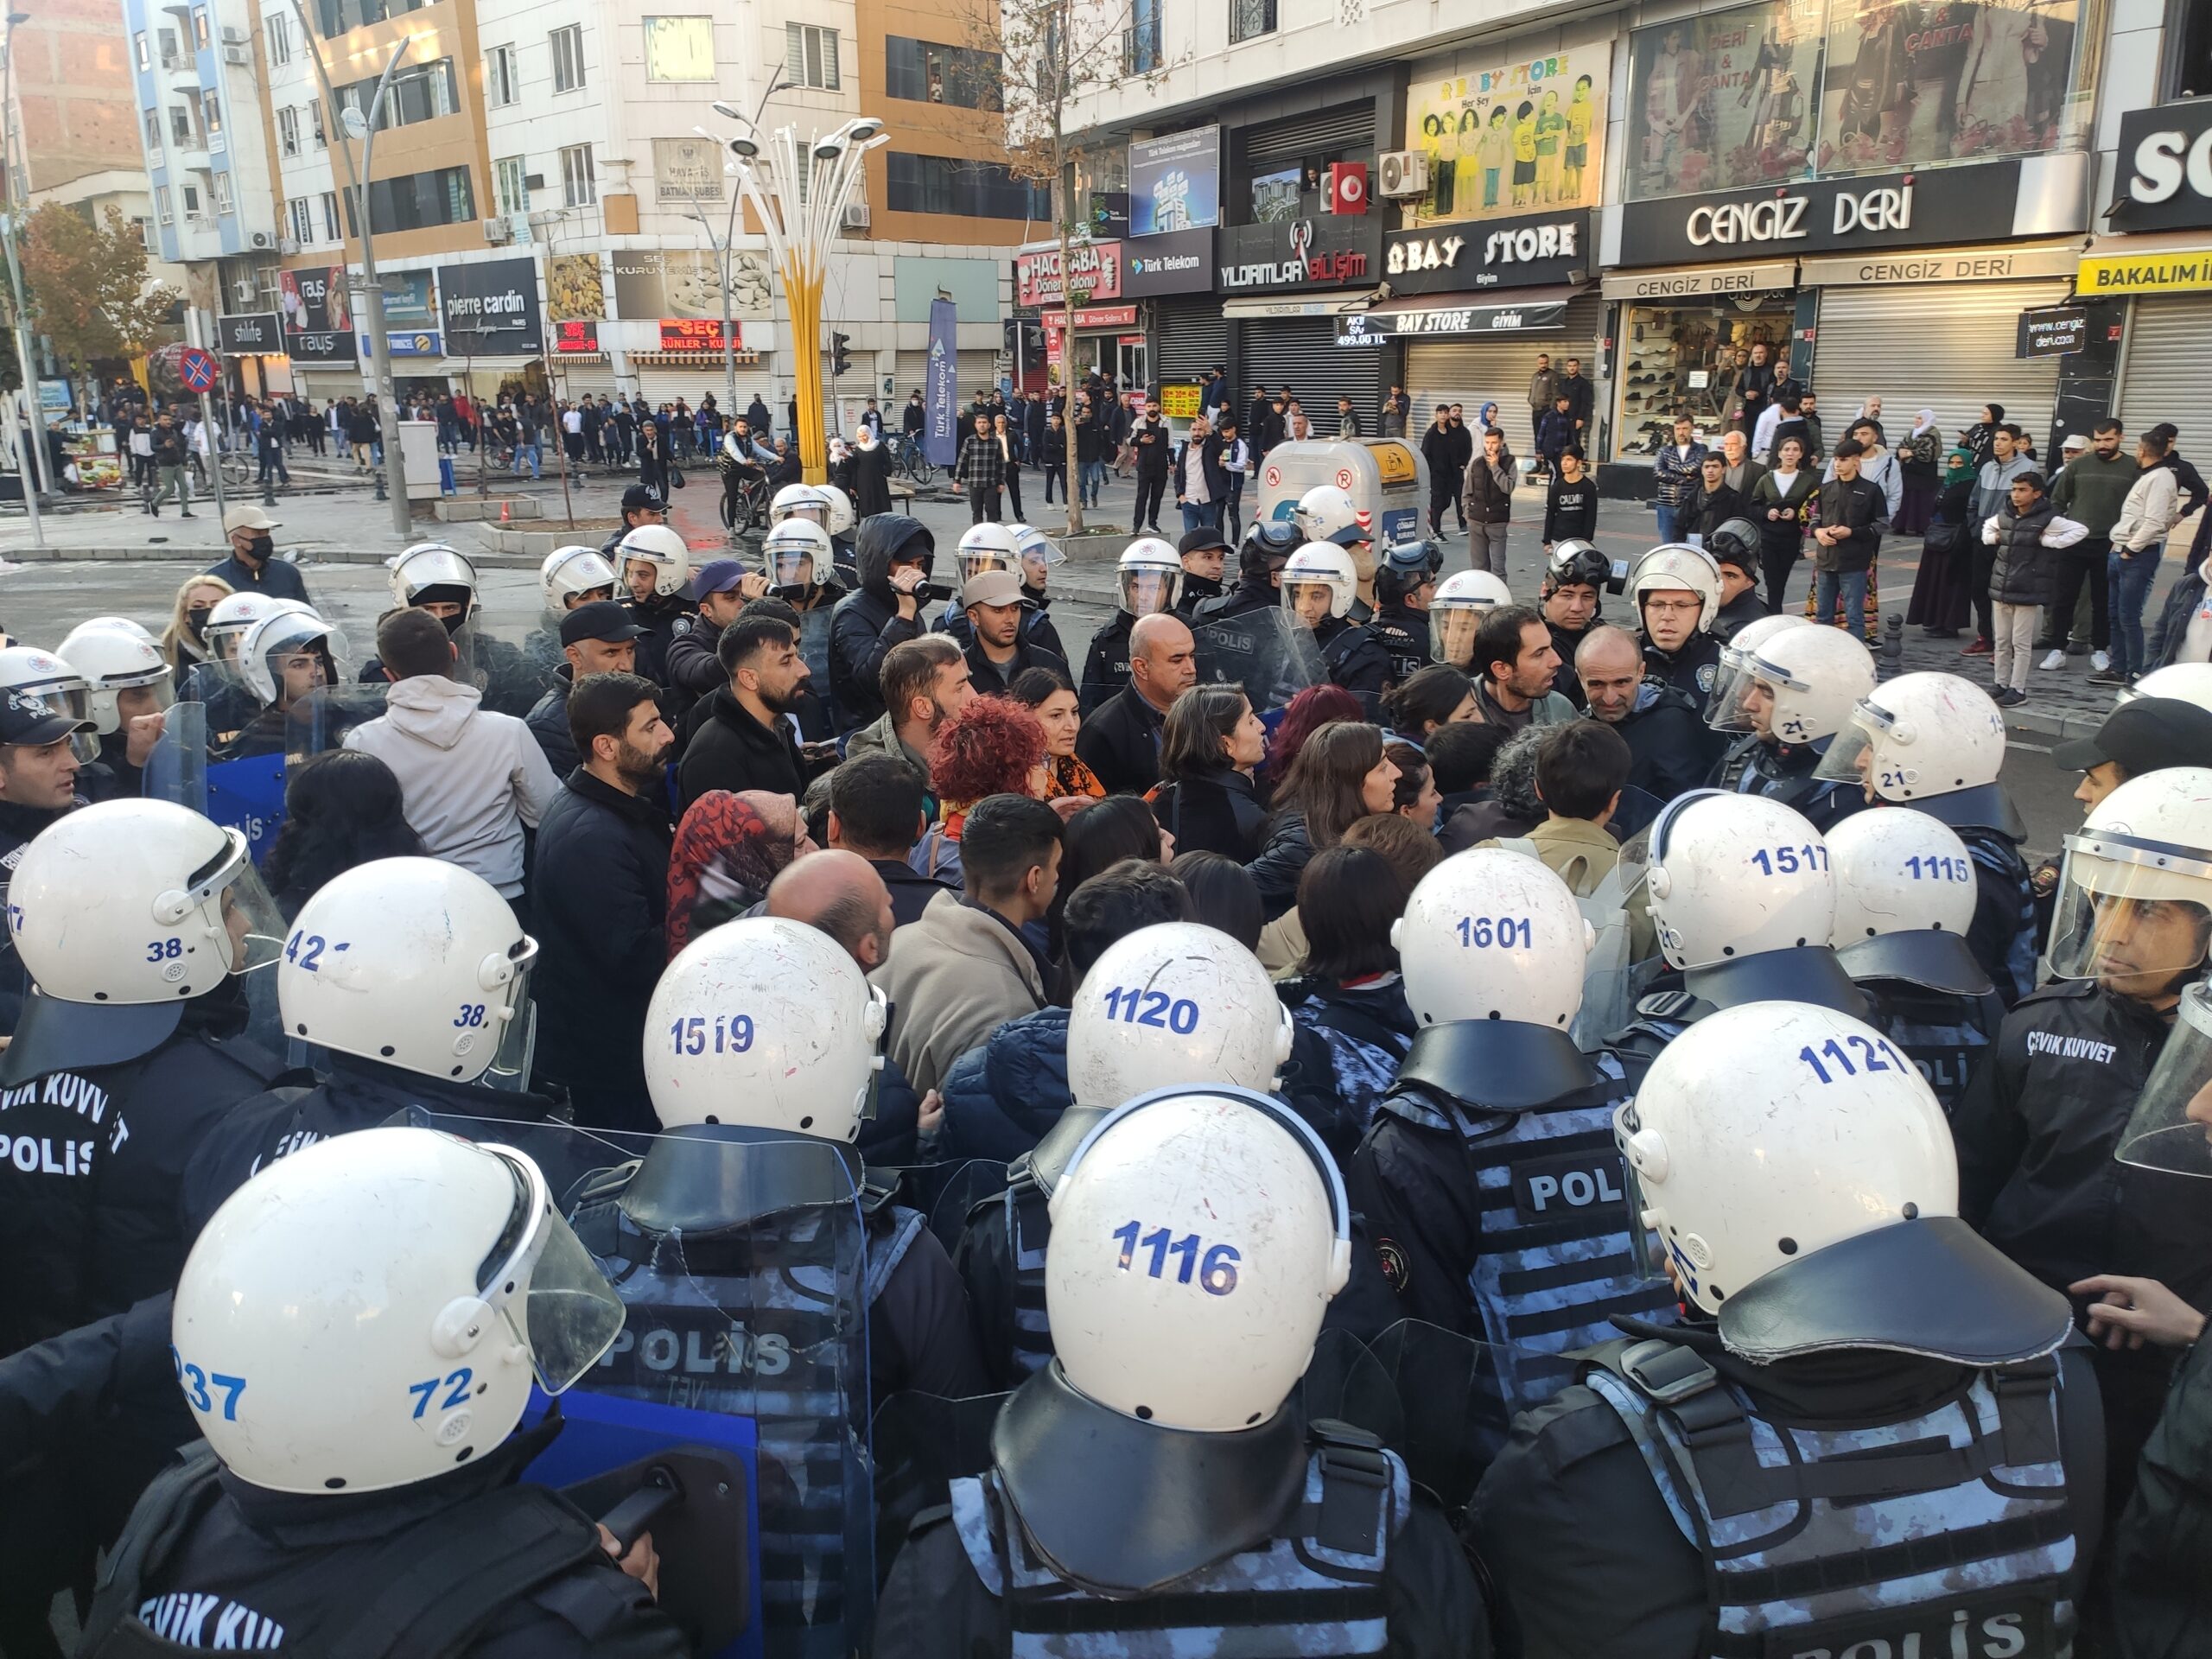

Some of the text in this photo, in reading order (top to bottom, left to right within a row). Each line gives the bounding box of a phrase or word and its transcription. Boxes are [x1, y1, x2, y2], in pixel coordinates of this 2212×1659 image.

[1456, 70, 1504, 98] BABY
[1510, 55, 1569, 87] STORE
[1462, 98, 1476, 110] Her
[1687, 175, 1916, 246] CENGİZ DERİ
[1406, 222, 1580, 271] BAY STORE
[1143, 254, 1200, 273] Türk Telekom
[1859, 255, 2013, 281] CENGİZ DERİ
[2096, 263, 2198, 287] BAKALIM
[302, 278, 326, 302] rays
[1070, 274, 1096, 289] alonu
[1637, 271, 1756, 296] CENGİZ DERİ
[447, 289, 525, 321] pierre cardin
[1396, 310, 1523, 334] BAY STORE GİYİM
[300, 334, 335, 356] rays
[935, 360, 947, 438] Türk Telekom
[1782, 721, 1804, 734] 21
[1880, 771, 1905, 787] 21
[1751, 843, 1829, 876] 1517
[1904, 855, 1969, 883] 1115
[1457, 917, 1531, 949] 1601
[147, 938, 182, 963] 38
[454, 1004, 486, 1027] 38
[1104, 987, 1199, 1035] 1120
[671, 1014, 754, 1056] 1519
[1799, 1035, 1909, 1084] 1121
[2063, 1037, 2117, 1065] KUVVET
[1112, 1220, 1242, 1296] 1116
[599, 1320, 791, 1376] POLİS
[410, 1368, 474, 1420] 72
